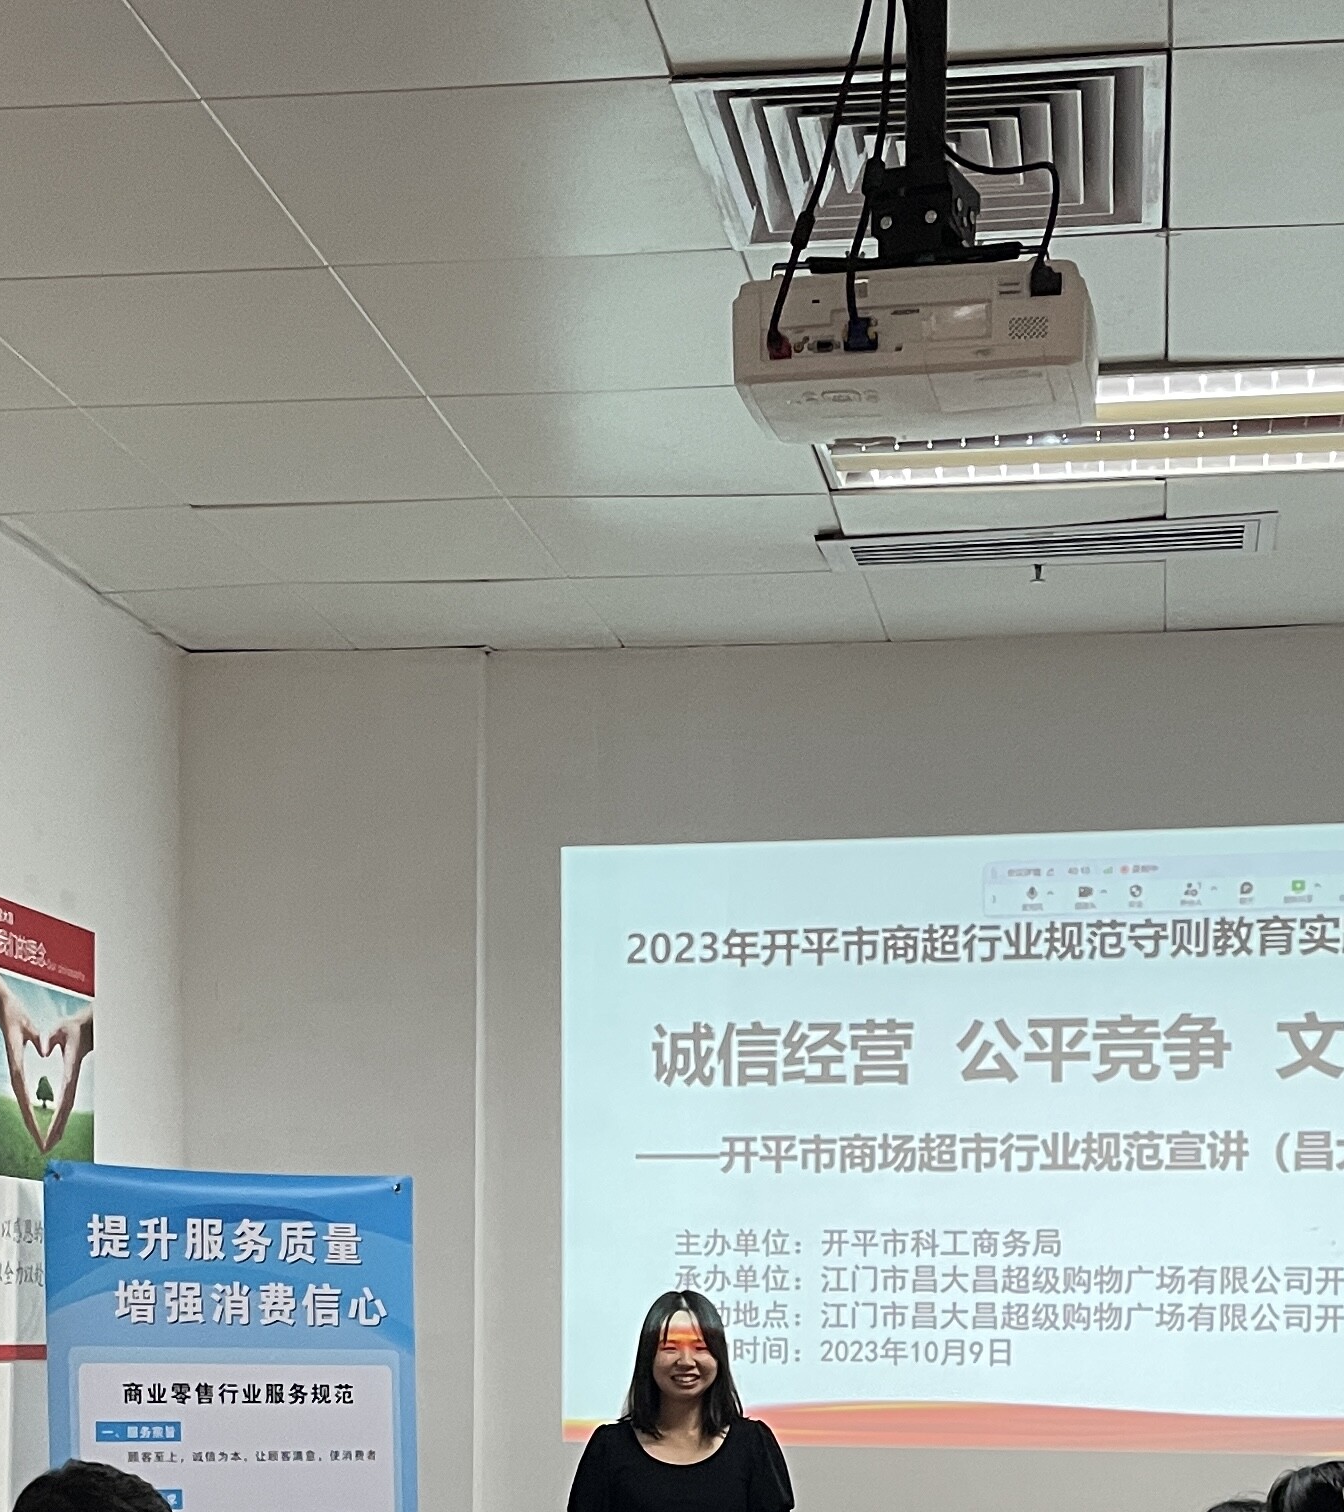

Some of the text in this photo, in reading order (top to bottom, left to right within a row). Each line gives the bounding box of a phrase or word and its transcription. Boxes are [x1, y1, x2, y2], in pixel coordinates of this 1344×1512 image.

[652, 1018, 915, 1087] 诚信经营
[956, 1012, 1232, 1084] 公平竞争
[87, 1213, 363, 1266] 提升服务质量
[114, 1279, 388, 1327] 增强消费信心
[726, 1336, 1013, 1368] 时间：2023年10月9日
[122, 1382, 355, 1405] 商业零售行业服务规范
